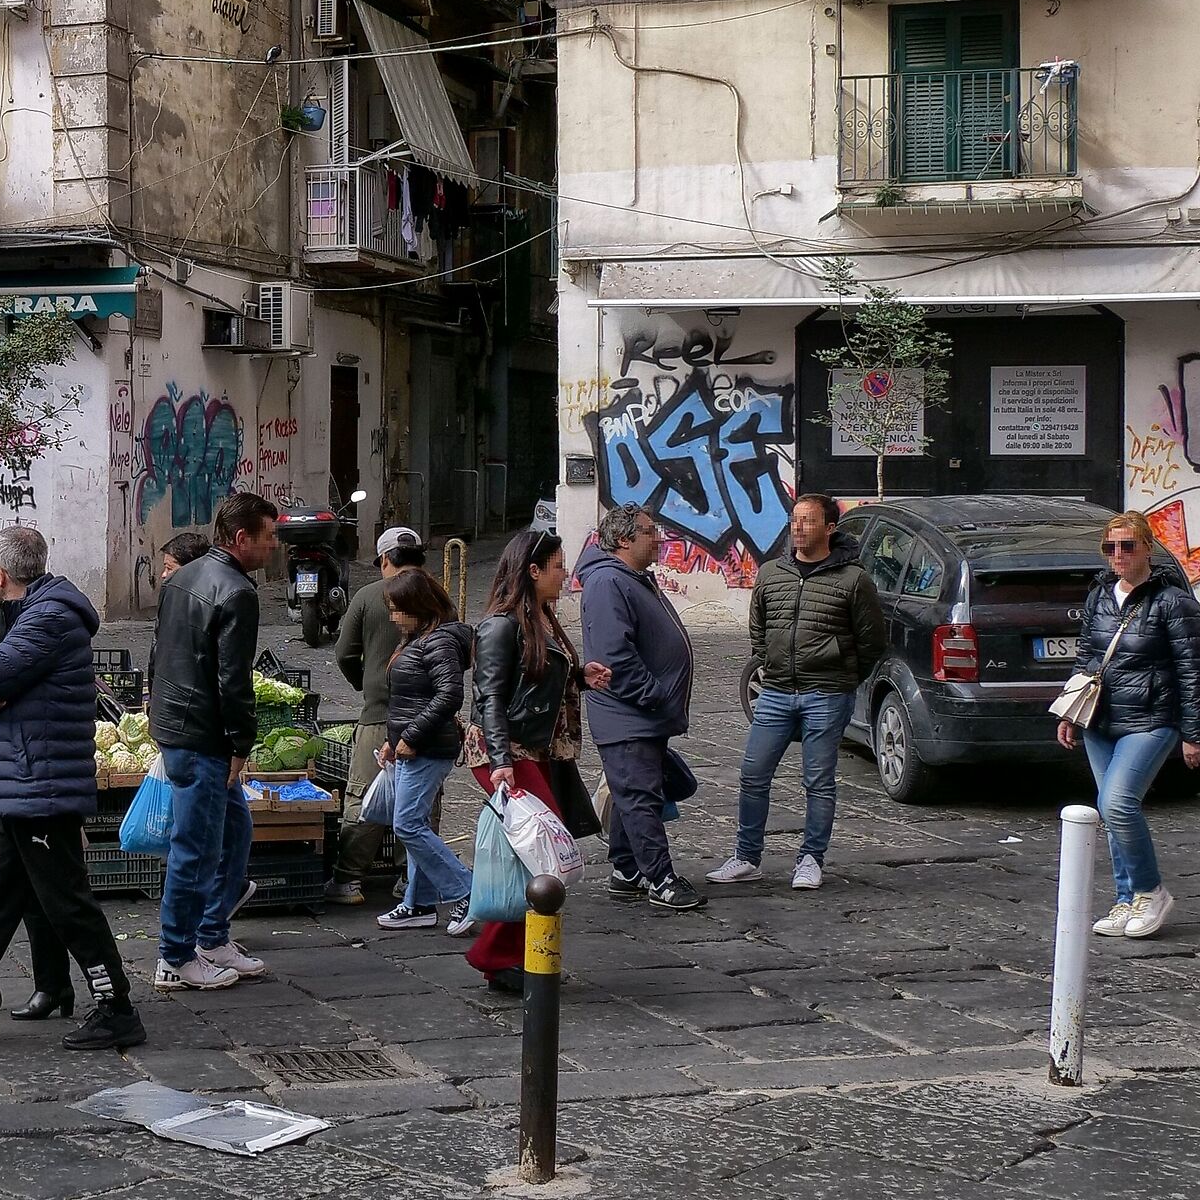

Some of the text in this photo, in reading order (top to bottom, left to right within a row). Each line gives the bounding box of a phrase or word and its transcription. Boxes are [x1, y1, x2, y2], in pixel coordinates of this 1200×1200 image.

[1021, 388, 1036, 397] oggi
[1042, 388, 1079, 396] disponibile
[1007, 397, 1033, 405] servizio
[1041, 397, 1075, 405] spedizioni
[840, 434, 855, 443] LA
[985, 659, 1008, 668] A2
